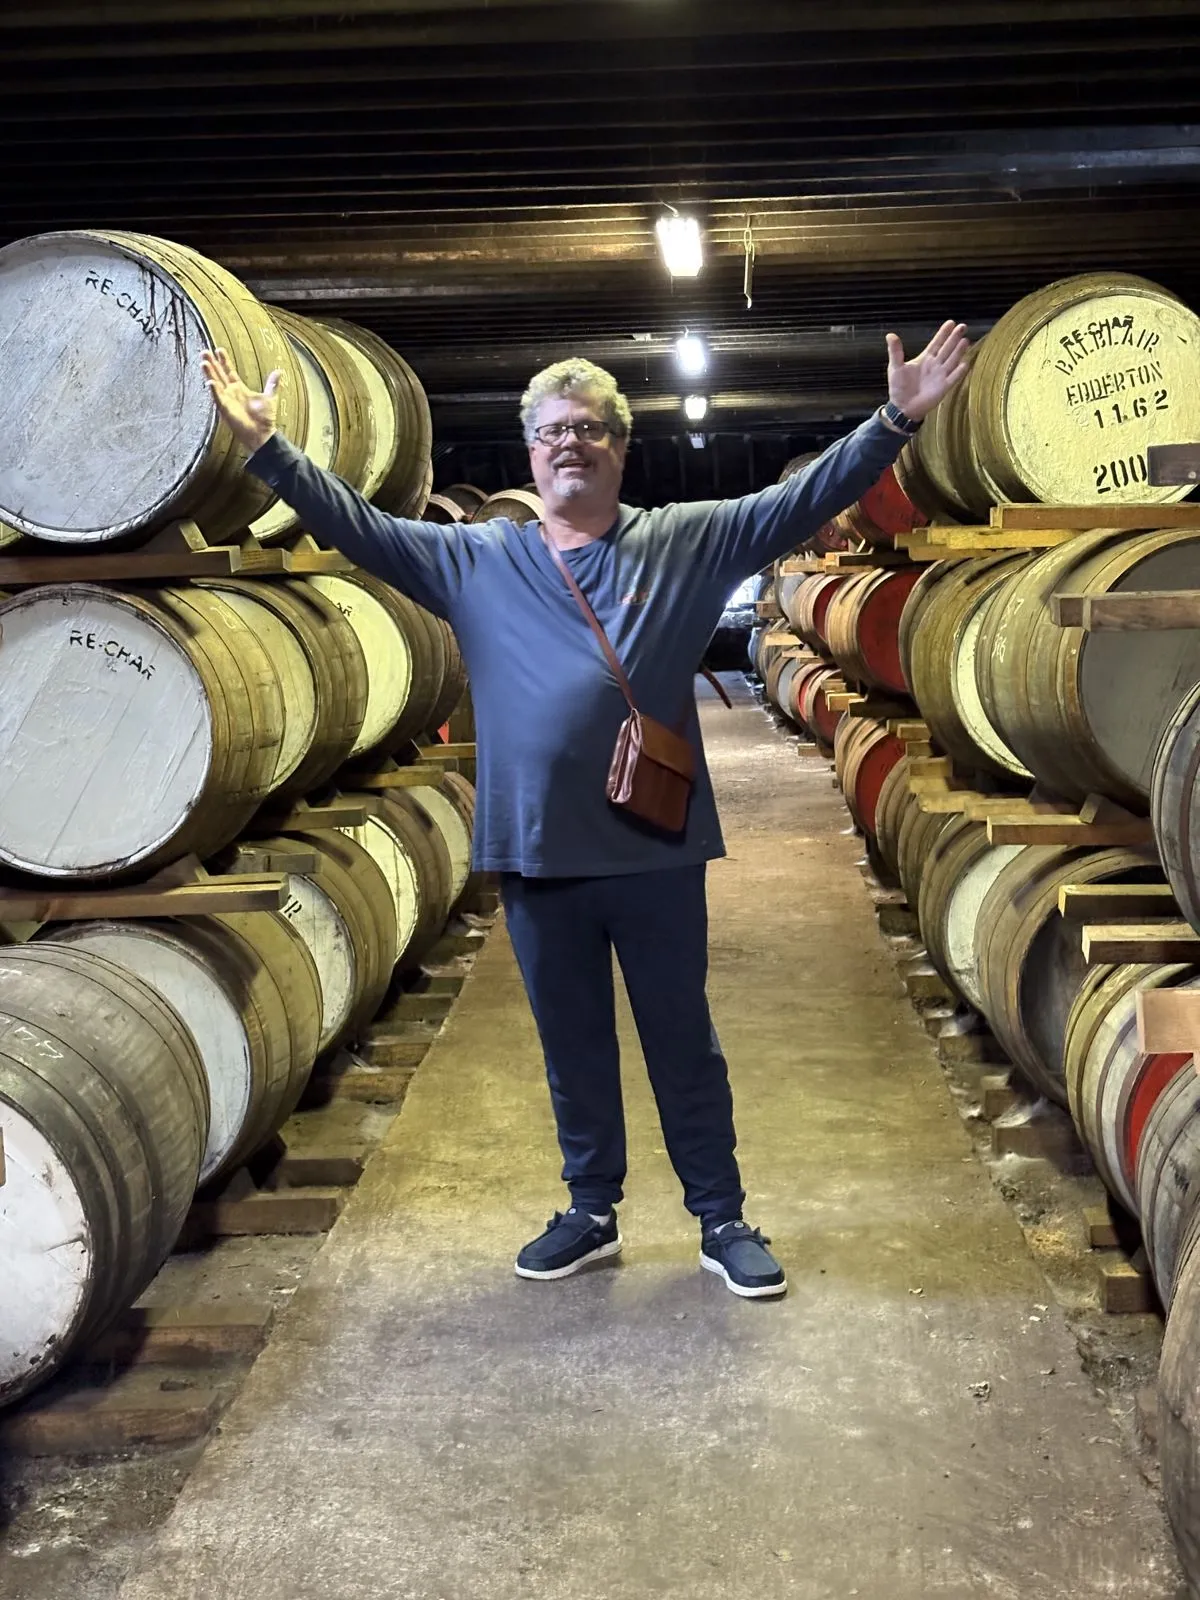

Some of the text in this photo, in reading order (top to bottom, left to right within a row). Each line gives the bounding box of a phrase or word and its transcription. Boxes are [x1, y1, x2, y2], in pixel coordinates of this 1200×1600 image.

[1066, 361, 1163, 406] EDDERTON
[1093, 454, 1147, 494] 200
[69, 630, 156, 680] RE-CHAR
